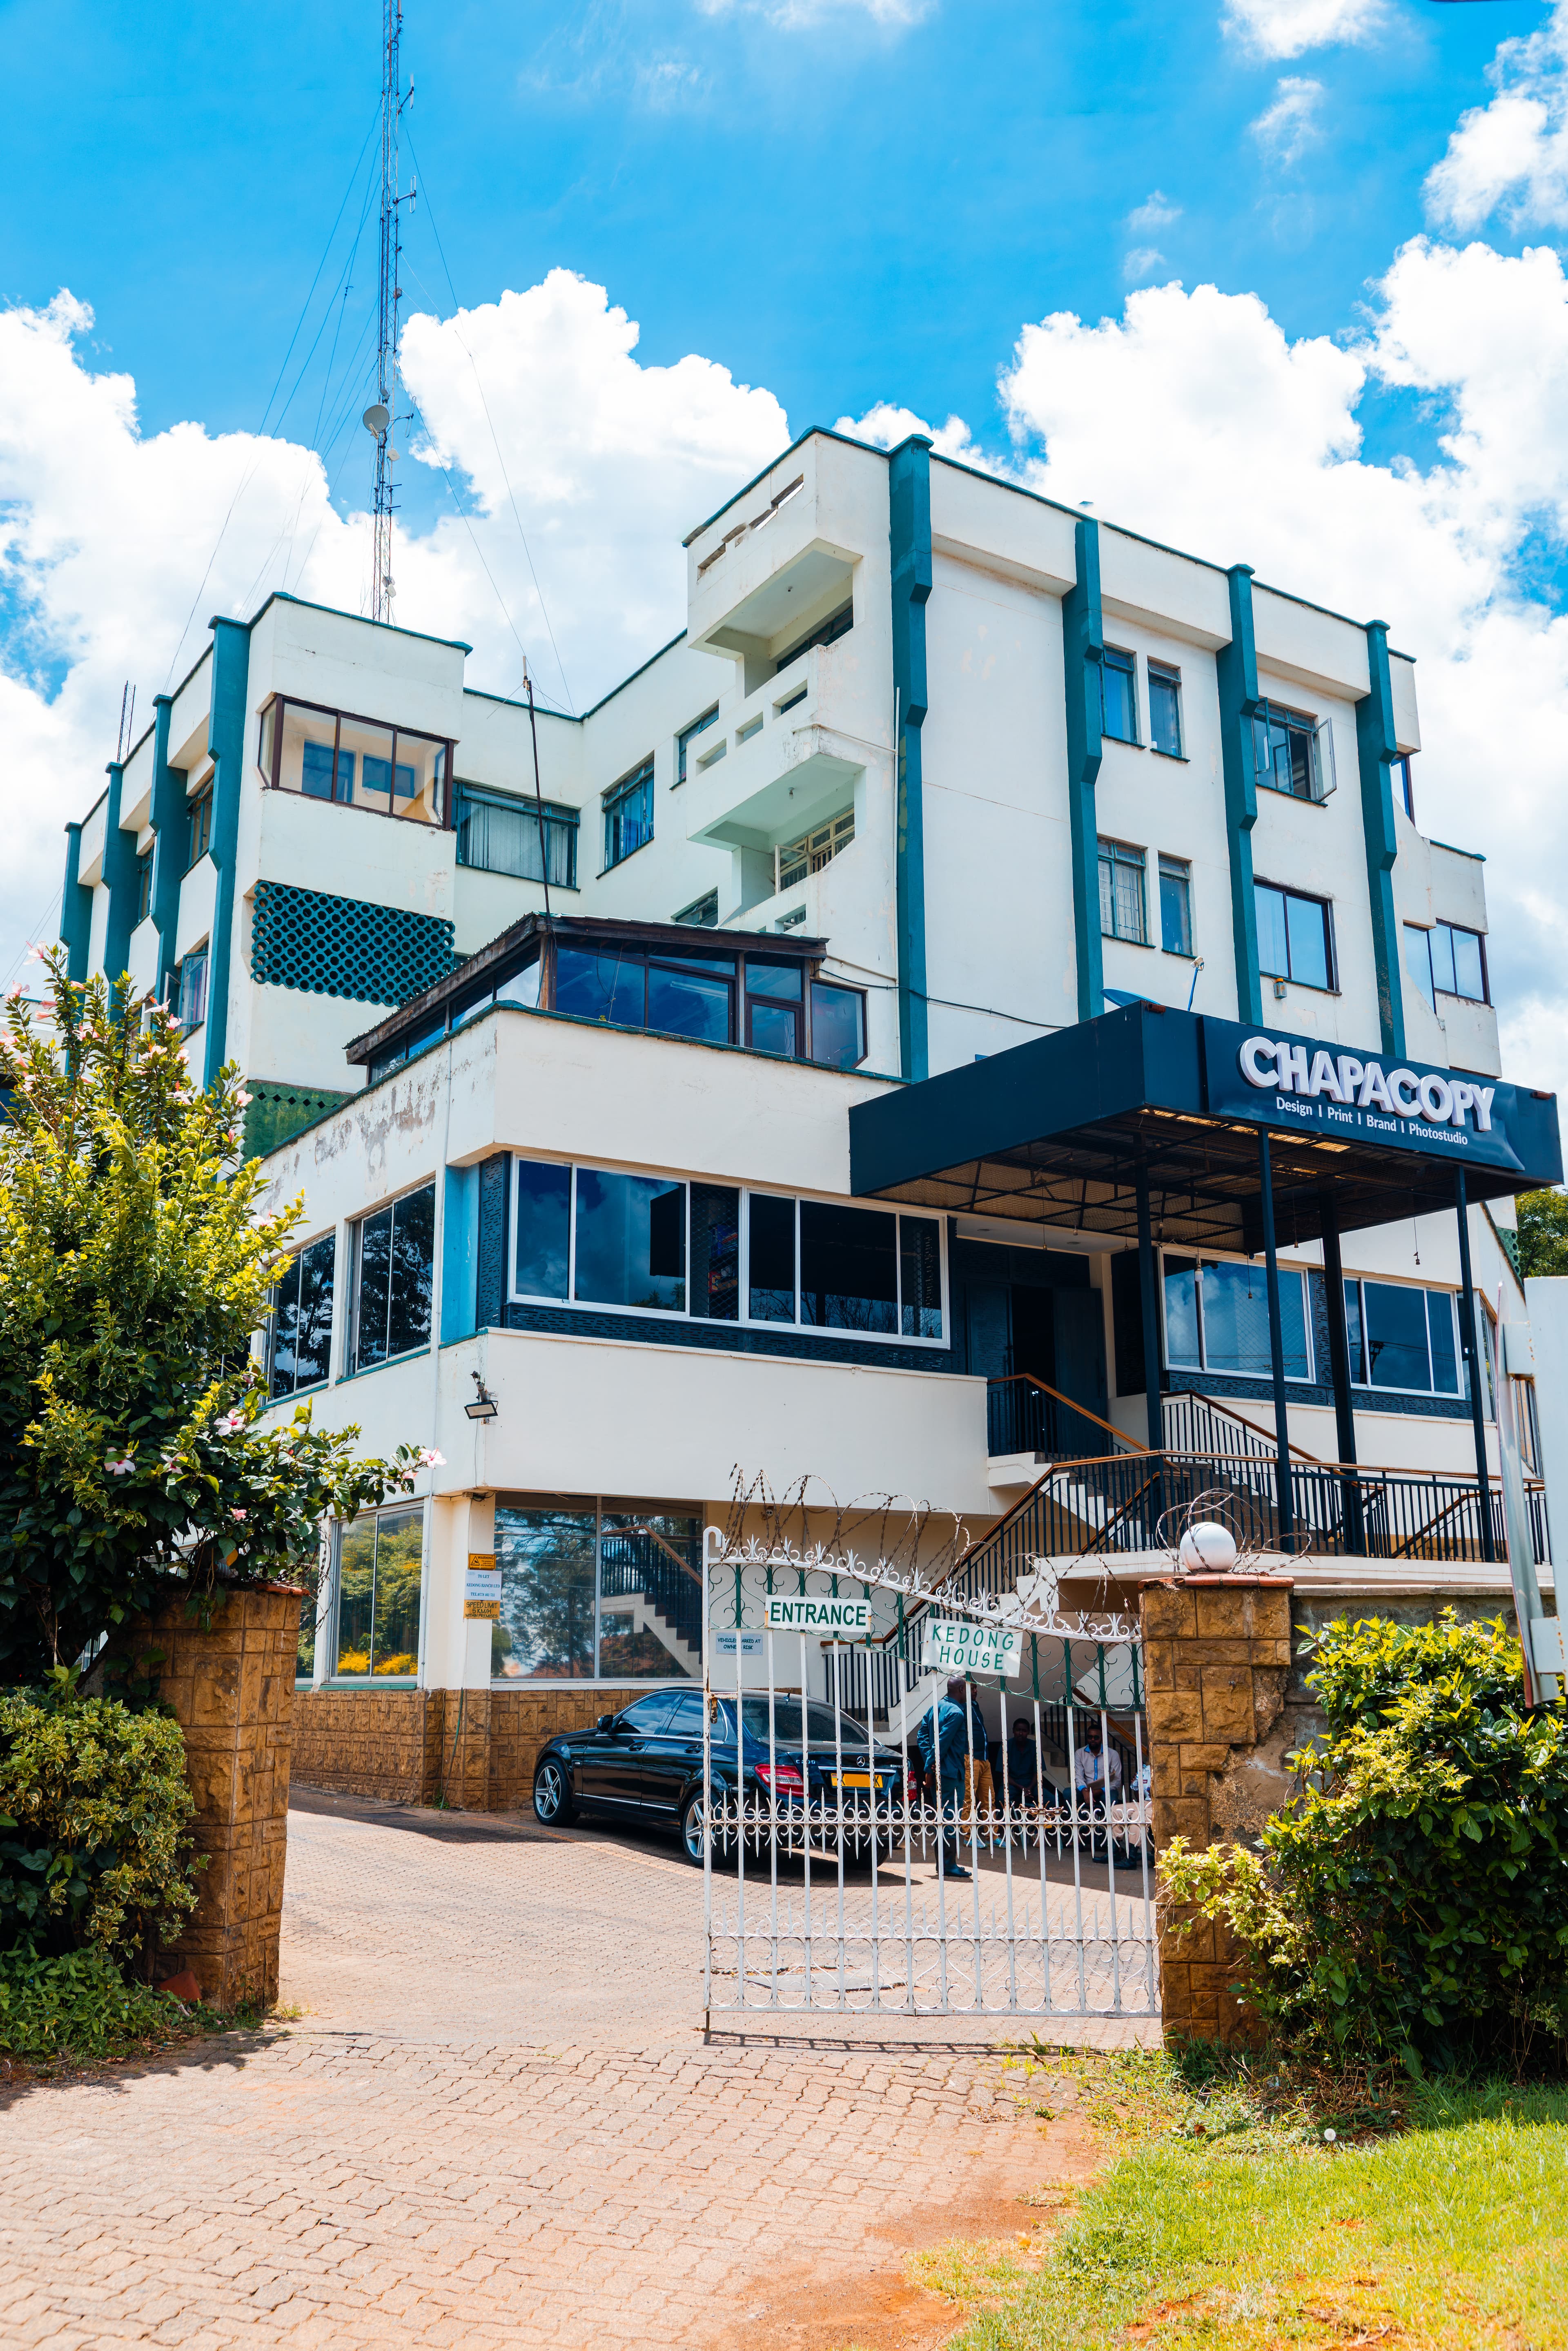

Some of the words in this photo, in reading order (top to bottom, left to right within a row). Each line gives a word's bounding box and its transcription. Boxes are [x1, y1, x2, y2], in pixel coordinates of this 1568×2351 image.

[1240, 1036, 1495, 1132] CHAPACOPY
[1276, 1096, 1313, 1117] Design
[1327, 1106, 1353, 1123] Print
[1367, 1114, 1396, 1132] Brand
[1409, 1122, 1468, 1145] Photostudio
[770, 1602, 866, 1626] ENTRANCE
[932, 1624, 1014, 1651] KEDONG
[940, 1645, 1004, 1670] HOUSE
